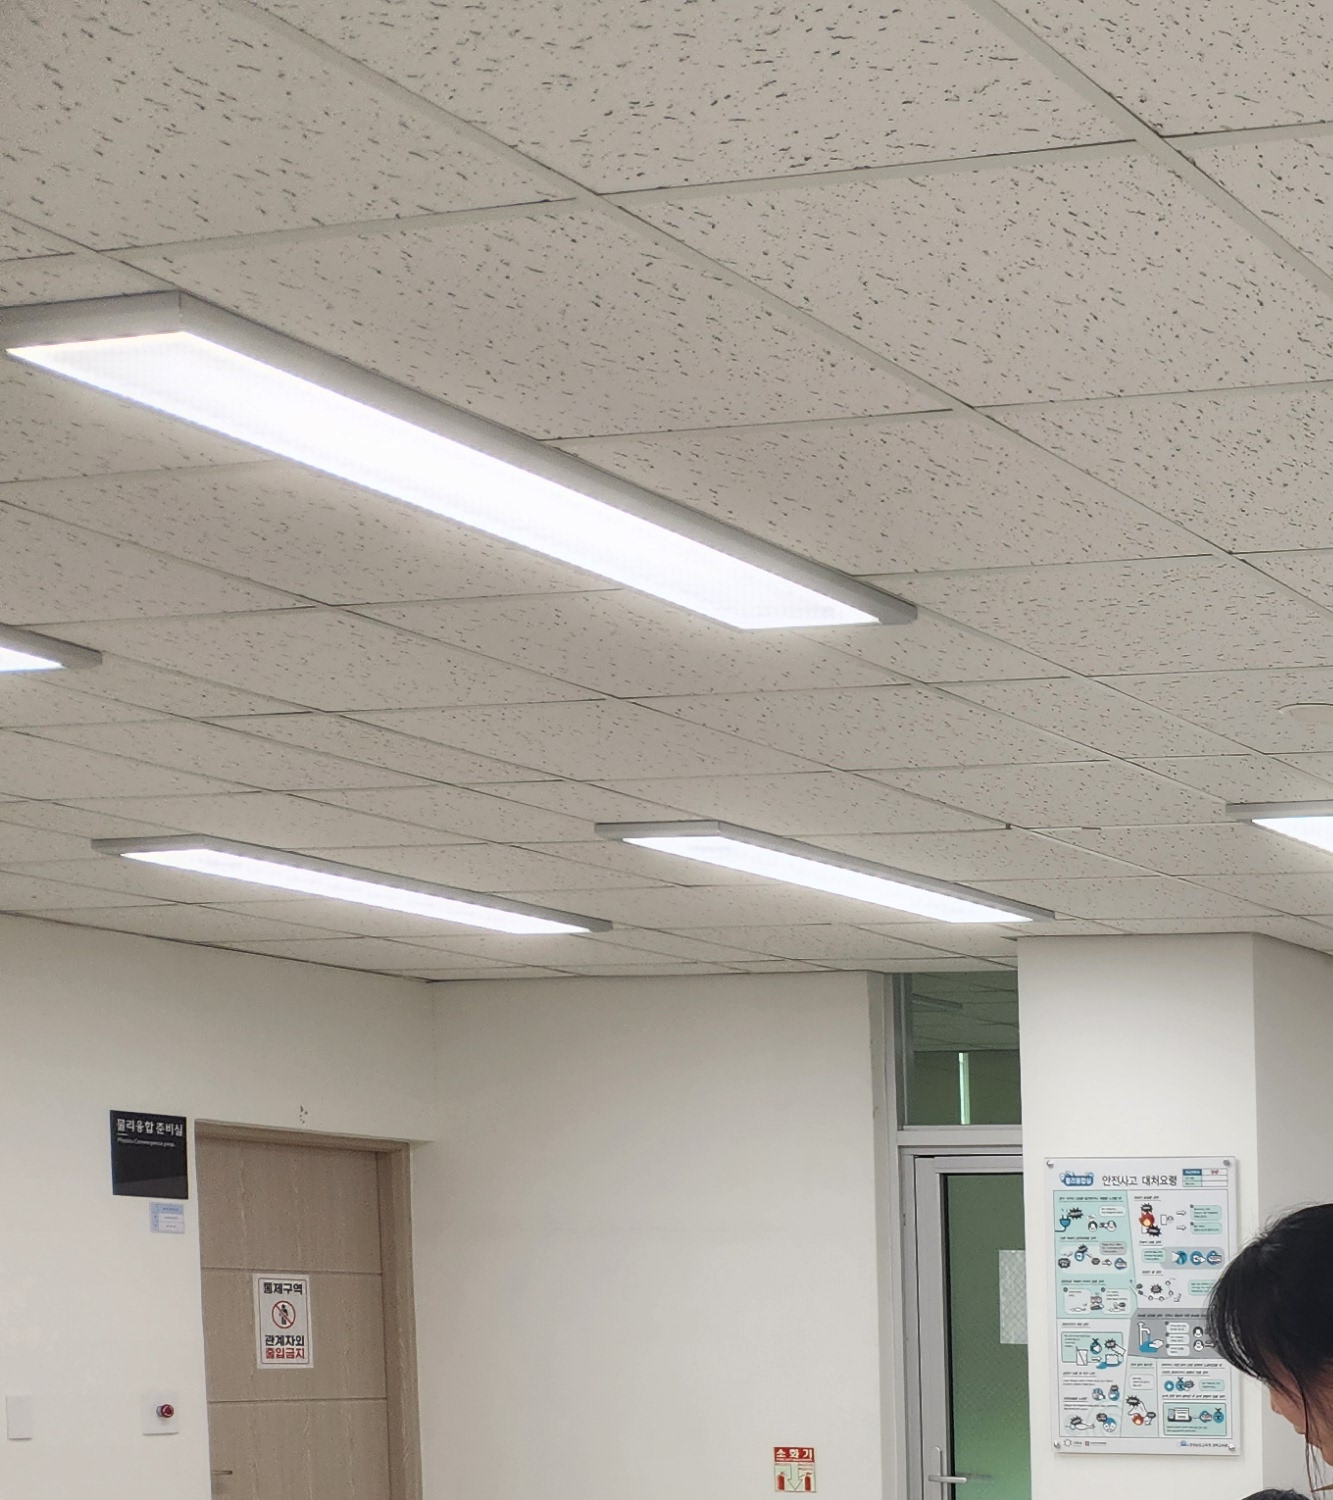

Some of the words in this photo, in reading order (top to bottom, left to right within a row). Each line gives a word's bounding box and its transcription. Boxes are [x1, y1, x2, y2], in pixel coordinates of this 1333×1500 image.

[1101, 1174, 1138, 1187] 안전사고
[1142, 1174, 1178, 1187] 대처요령
[263, 1282, 303, 1296] 통제구역
[265, 1334, 305, 1347] 관계자외
[265, 1347, 305, 1360] 출입금지
[775, 1448, 813, 1460] 소화기
